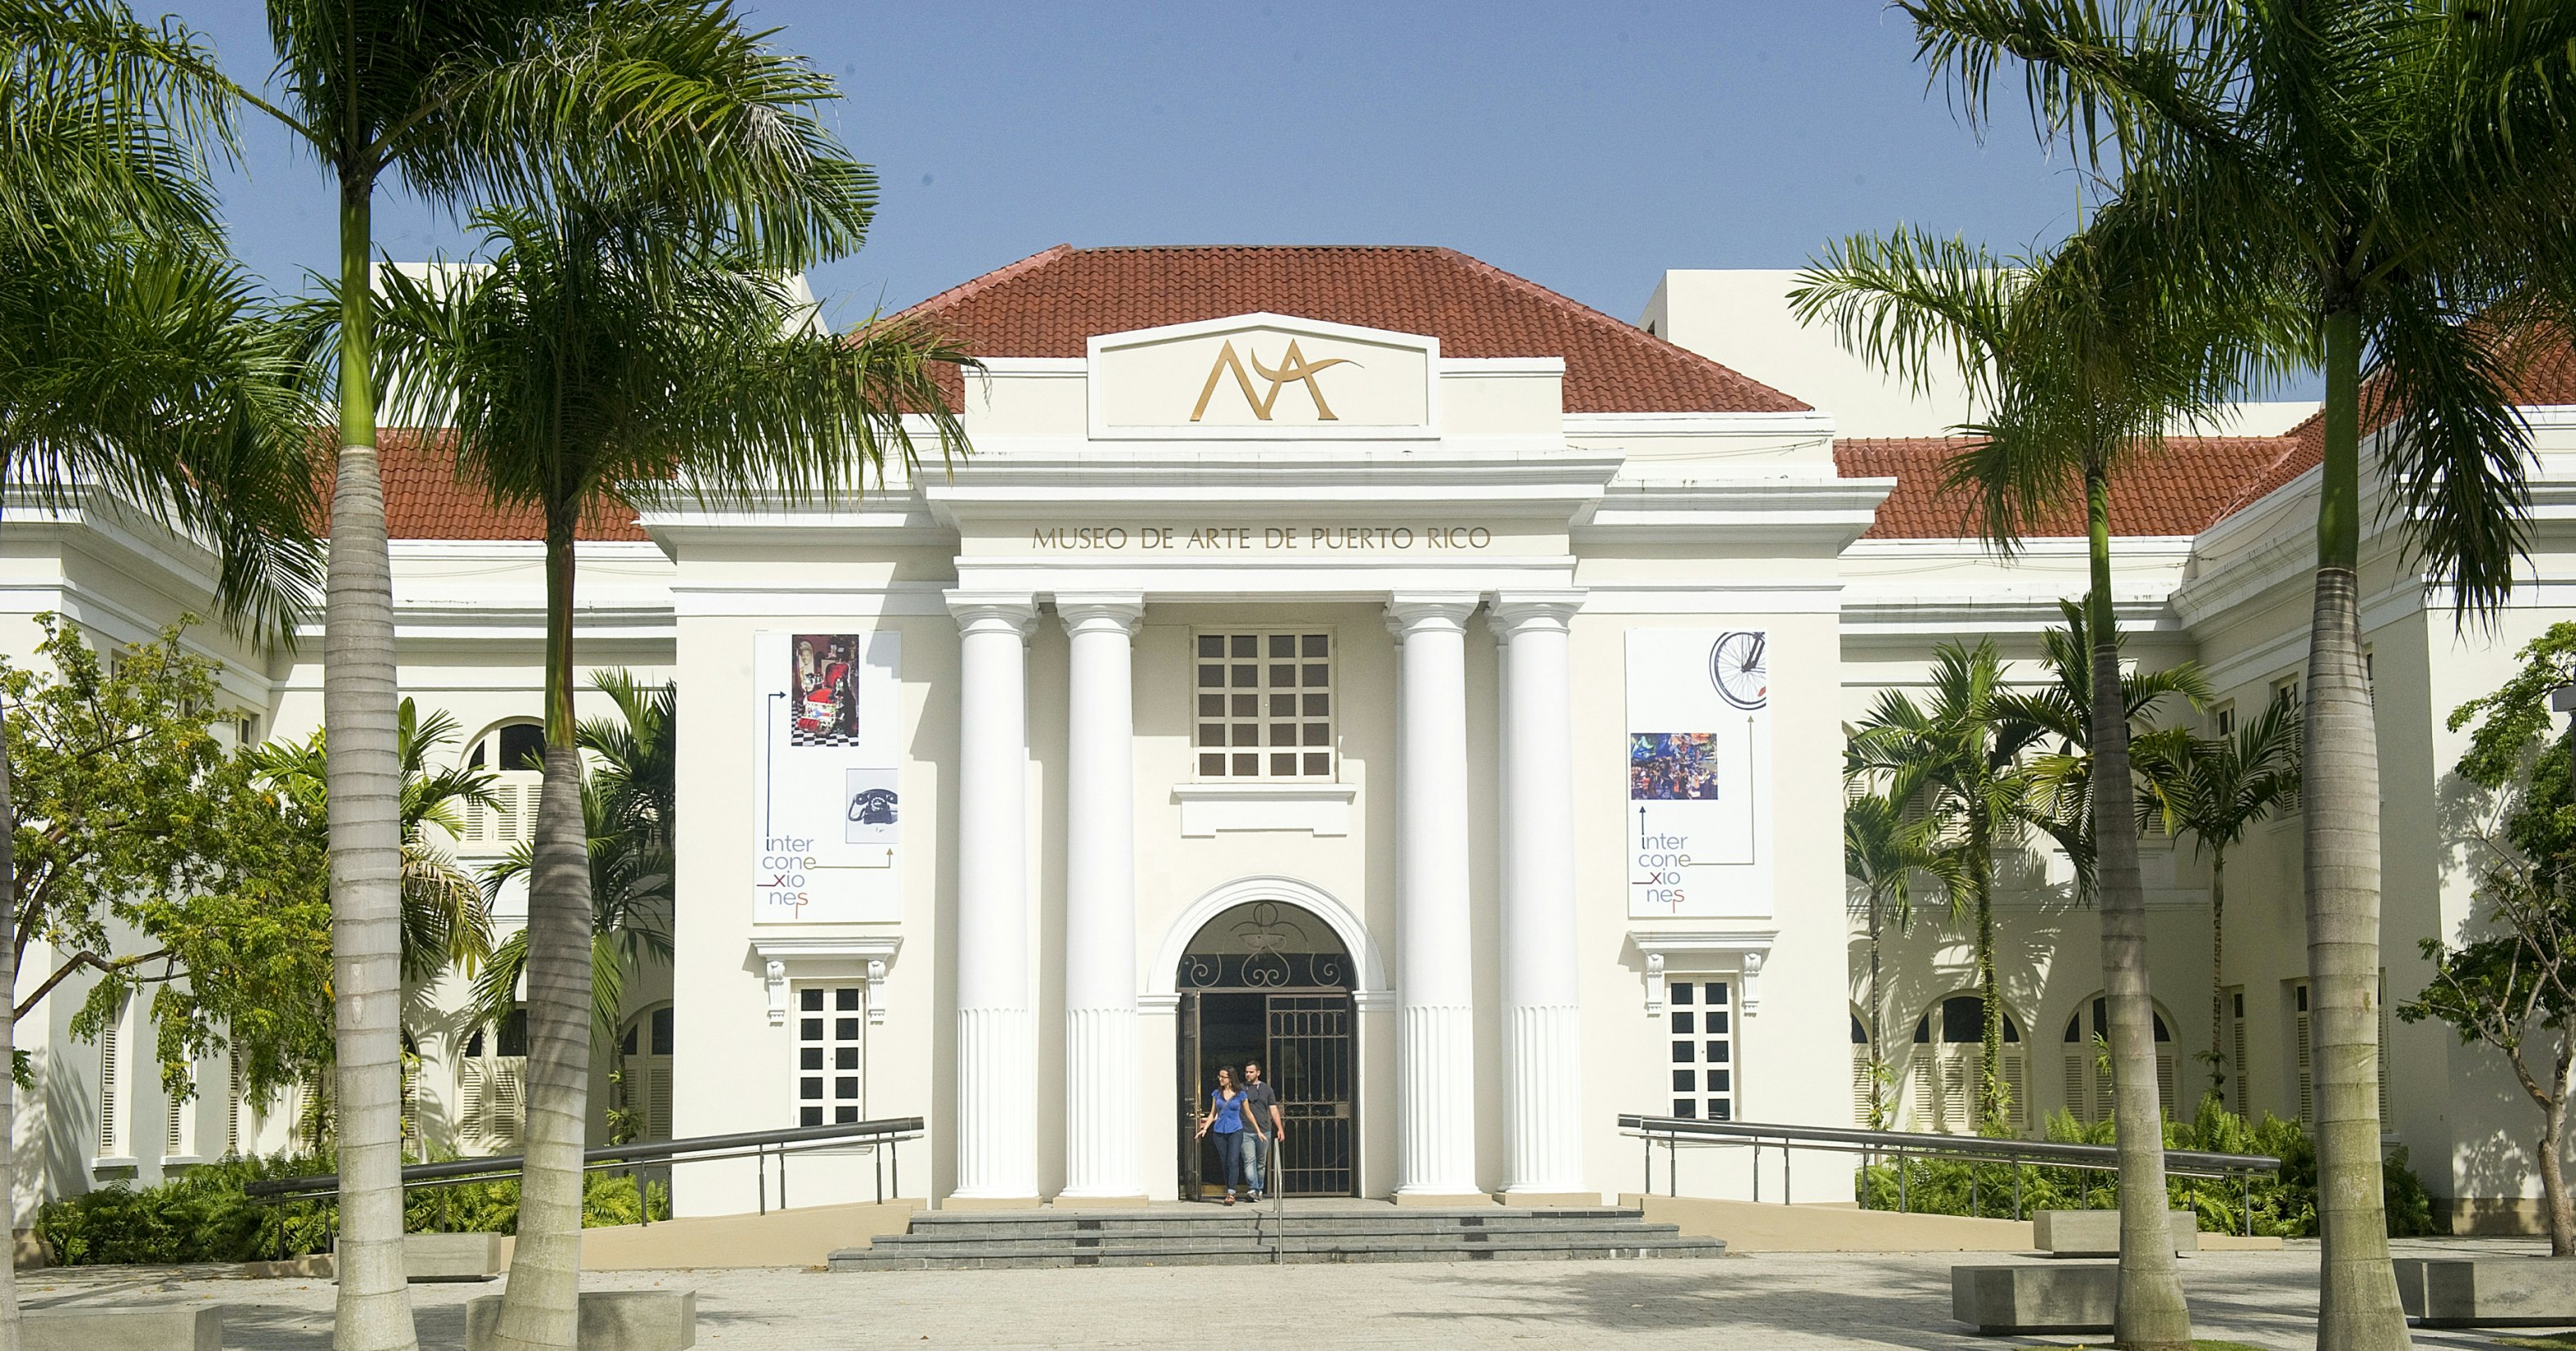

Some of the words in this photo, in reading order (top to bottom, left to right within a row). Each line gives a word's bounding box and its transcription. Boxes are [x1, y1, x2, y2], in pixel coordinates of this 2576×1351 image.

[1032, 527, 1128, 550] MUSEO
[1142, 528, 1174, 549] DE
[1186, 528, 1251, 550] ARTE
[1265, 528, 1298, 549] DE
[1311, 527, 1414, 550] PUERTO
[1427, 527, 1491, 549] RICO
[766, 835, 814, 852] inter
[1642, 833, 1688, 850] inter
[763, 856, 817, 870] cone
[1638, 853, 1691, 867] cone
[773, 870, 805, 888] xio
[1650, 867, 1681, 885] xio
[769, 892, 808, 919] nes
[1646, 889, 1685, 913] nes
